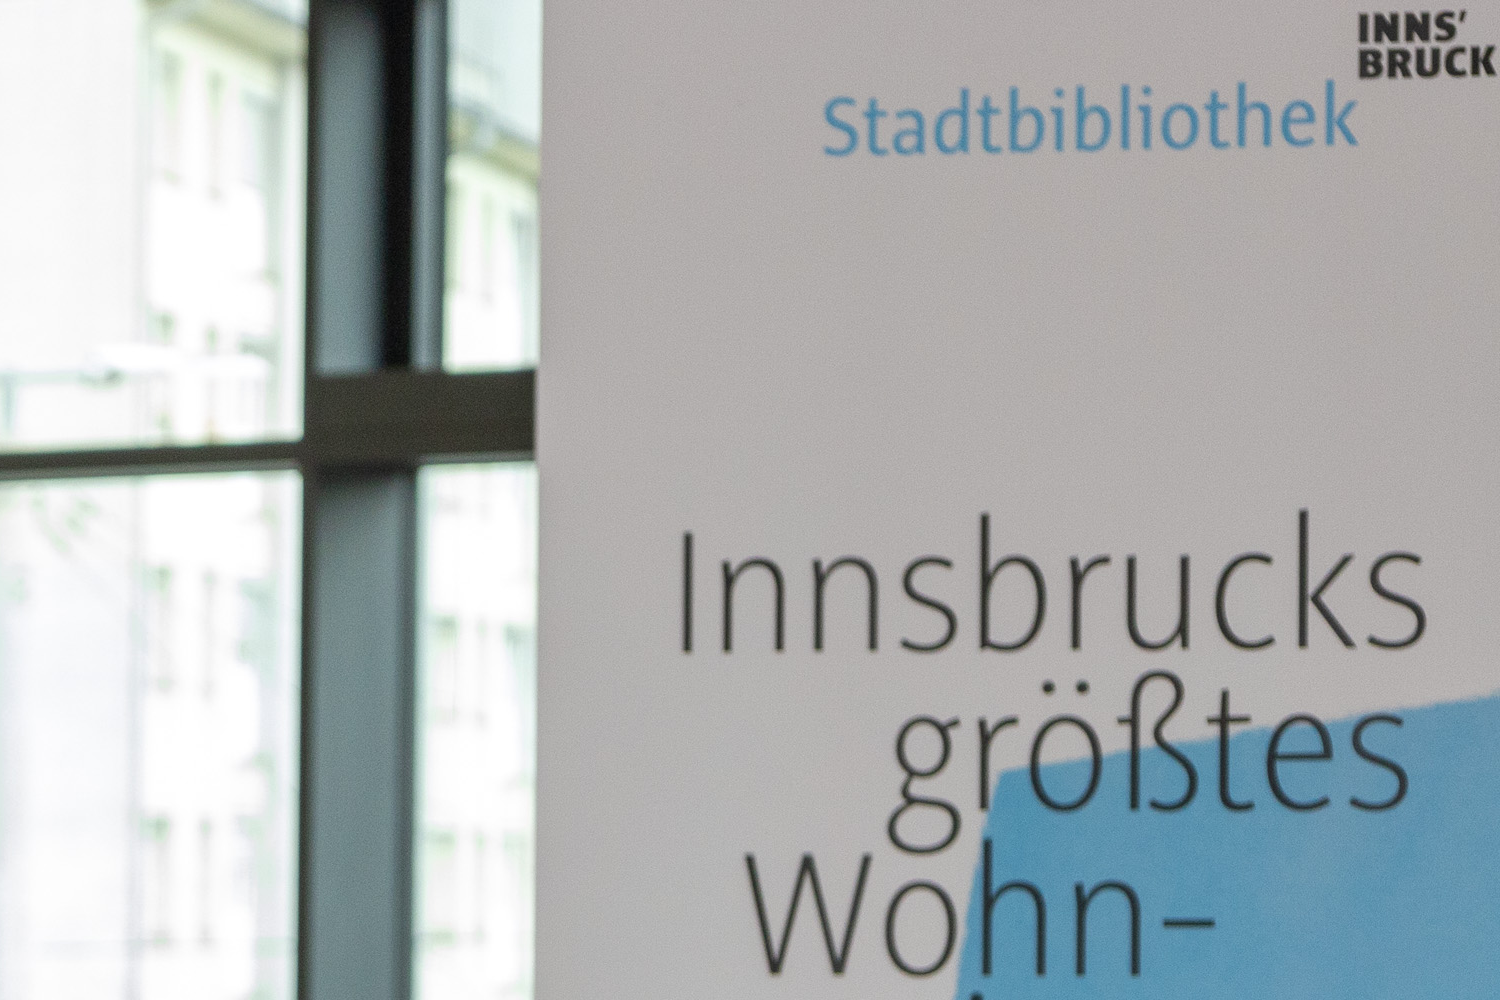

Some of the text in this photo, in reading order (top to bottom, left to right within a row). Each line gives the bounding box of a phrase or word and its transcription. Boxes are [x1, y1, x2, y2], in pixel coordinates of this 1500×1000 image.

[1357, 9, 1468, 44] INNS'
[1357, 45, 1498, 81] BRUCK
[822, 78, 1360, 157] Stadtbibliothek
[682, 508, 1428, 655] Innsbrucks
[886, 669, 1410, 855] größtes
[744, 837, 1217, 978] Wohn-
